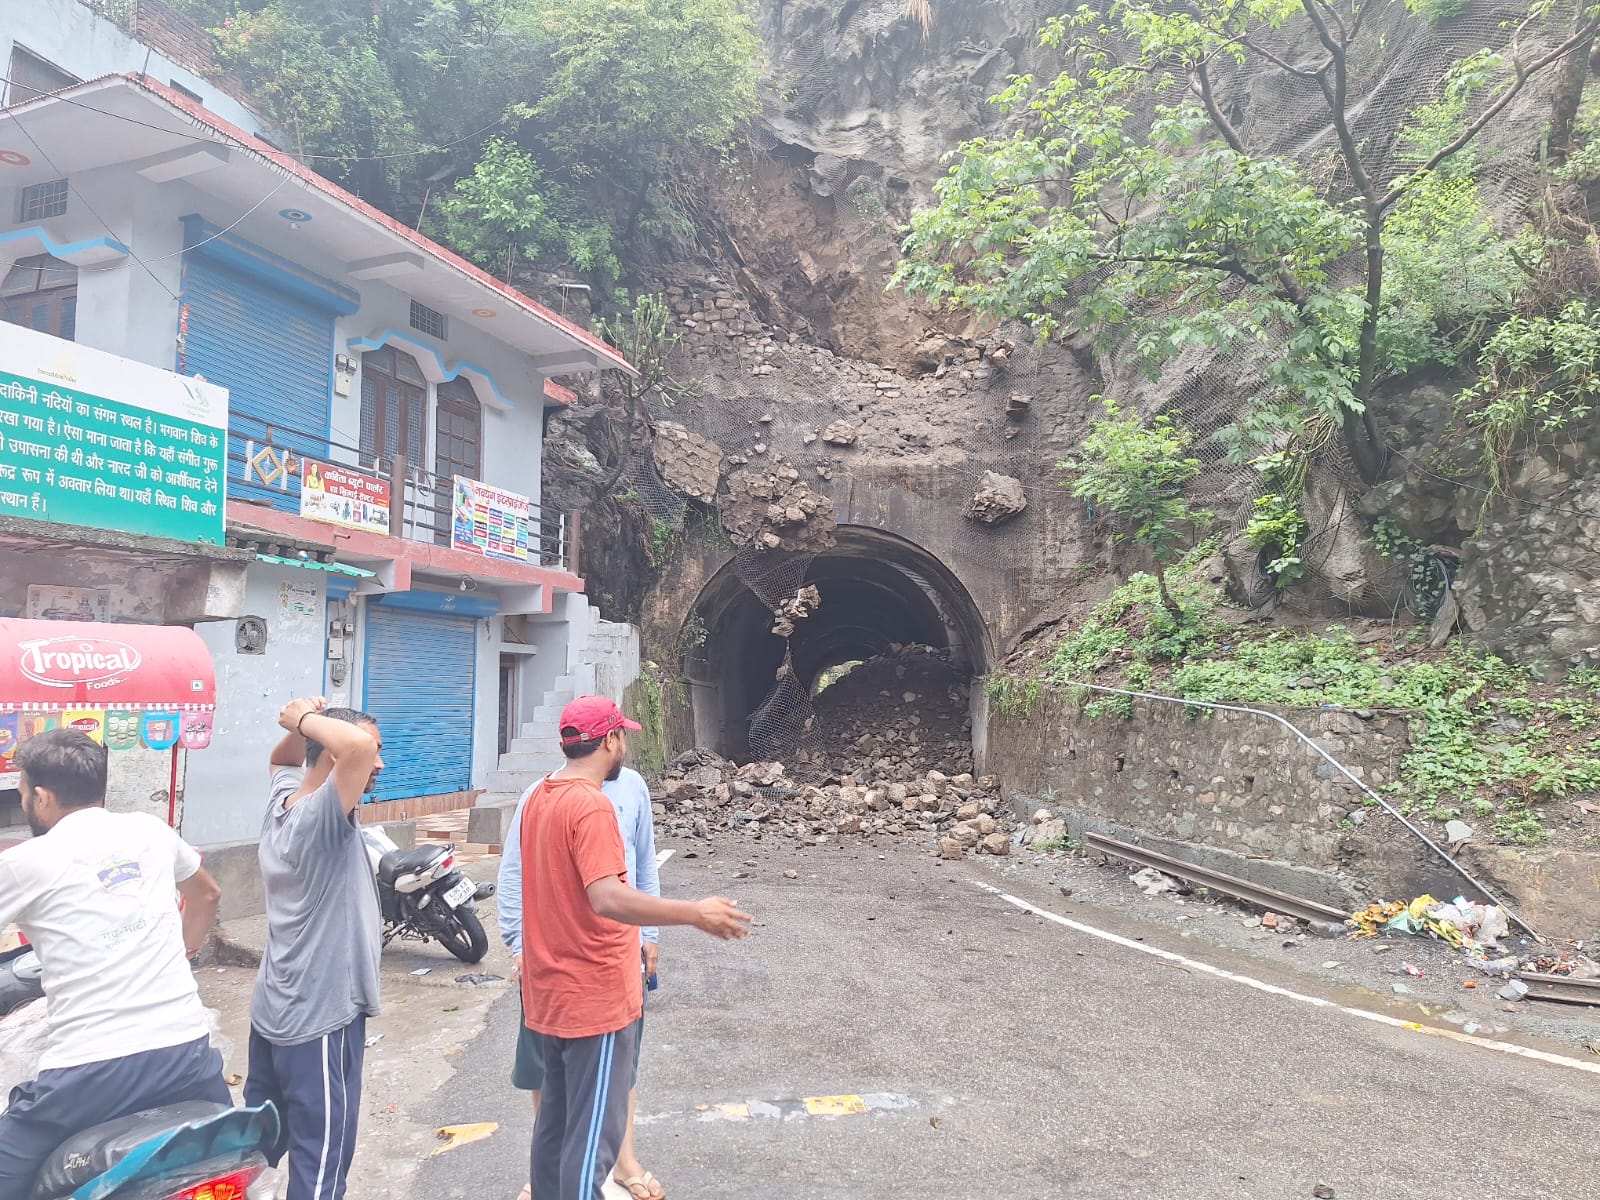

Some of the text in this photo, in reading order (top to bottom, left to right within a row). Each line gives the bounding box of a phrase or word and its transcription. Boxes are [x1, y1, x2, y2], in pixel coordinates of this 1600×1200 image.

[22, 415, 43, 432] गया
[63, 420, 83, 441] ऐसा
[86, 430, 108, 447] माना
[110, 436, 132, 453] जाता
[134, 437, 142, 456] है
[143, 439, 157, 457] कि
[159, 445, 175, 463] यहाँ
[177, 448, 201, 468] संगीत
[41, 390, 73, 413] नदियों
[75, 402, 90, 417] का
[93, 404, 117, 424] संगम
[120, 413, 142, 430] स्थल
[159, 423, 188, 442] भगवान
[190, 427, 207, 446] शिव
[209, 431, 219, 448] के
[8, 438, 51, 460] उपासना
[54, 444, 68, 463] की
[71, 447, 84, 467] थी
[85, 452, 105, 471] और
[107, 460, 132, 477] नारद
[134, 461, 147, 480] जी
[150, 465, 163, 482] को
[204, 476, 218, 494] देने
[21, 467, 41, 484] रूप
[45, 467, 55, 487] में
[58, 475, 92, 493] अवतार
[94, 477, 116, 498] लिया
[155, 488, 177, 509] स्थित
[181, 495, 198, 513] शिव
[200, 499, 217, 516] और
[18, 639, 134, 675] Tropical
